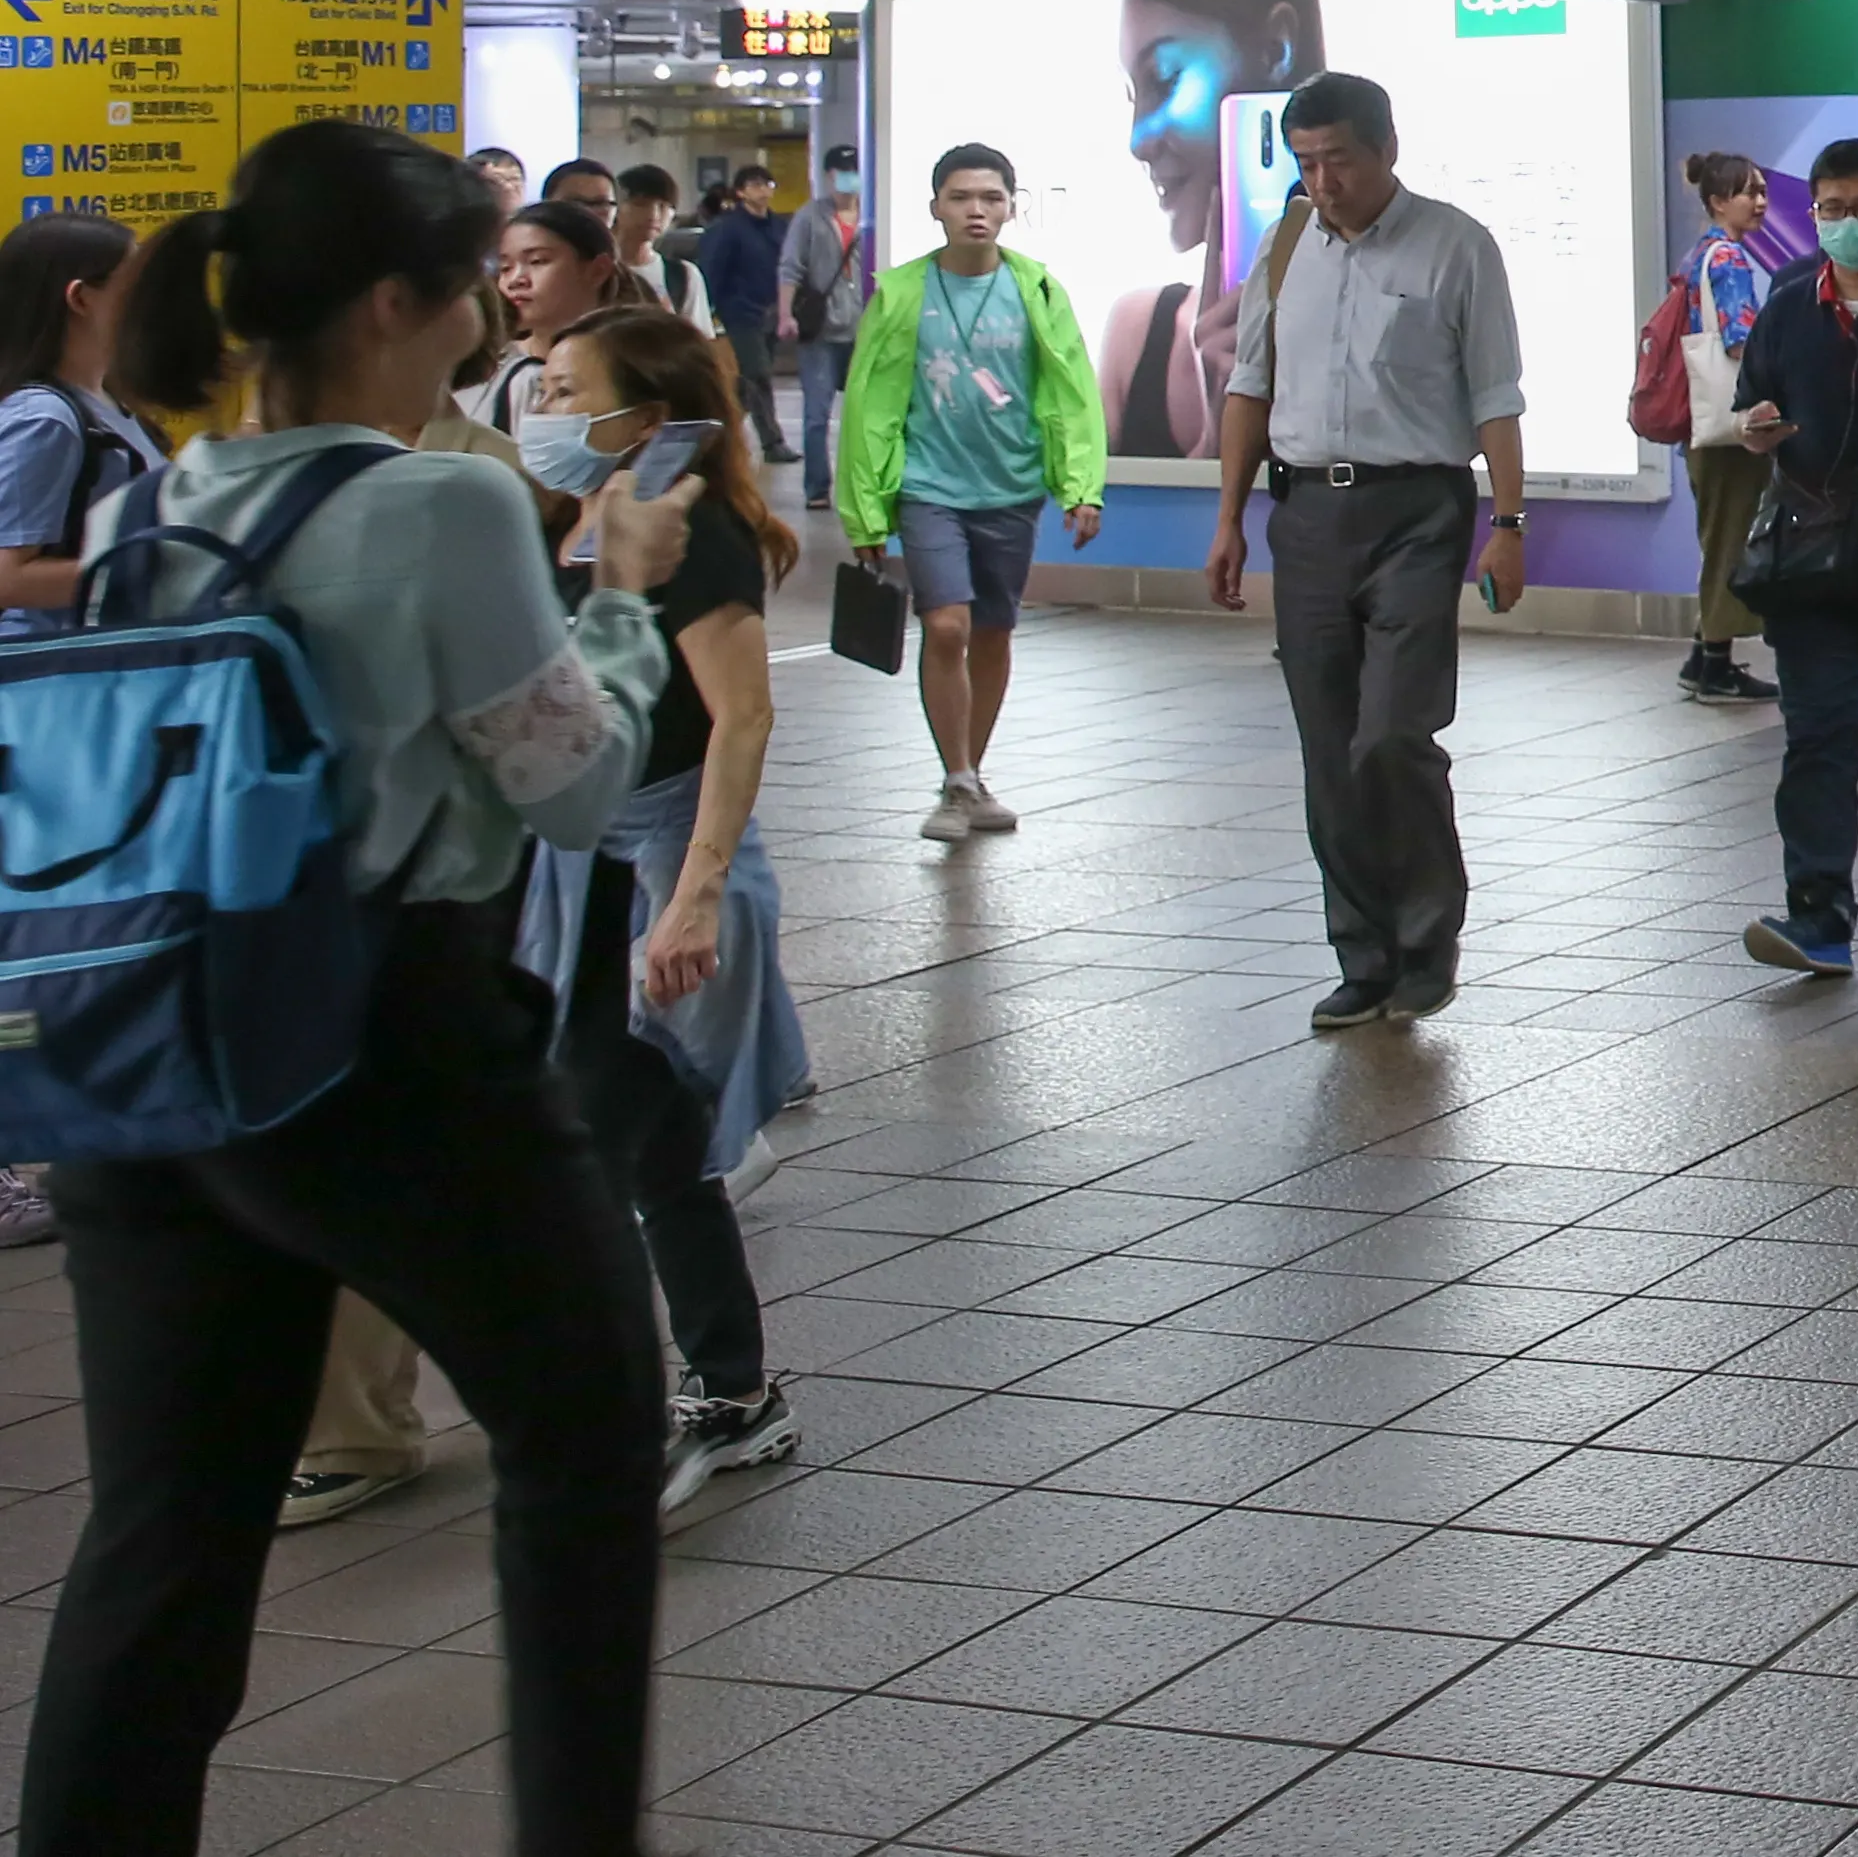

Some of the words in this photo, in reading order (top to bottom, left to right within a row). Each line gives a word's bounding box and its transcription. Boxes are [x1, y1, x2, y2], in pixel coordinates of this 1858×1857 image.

[63, 38, 107, 65] M4
[362, 41, 397, 67] M1
[62, 144, 108, 173] M5
[62, 195, 108, 218] M6
